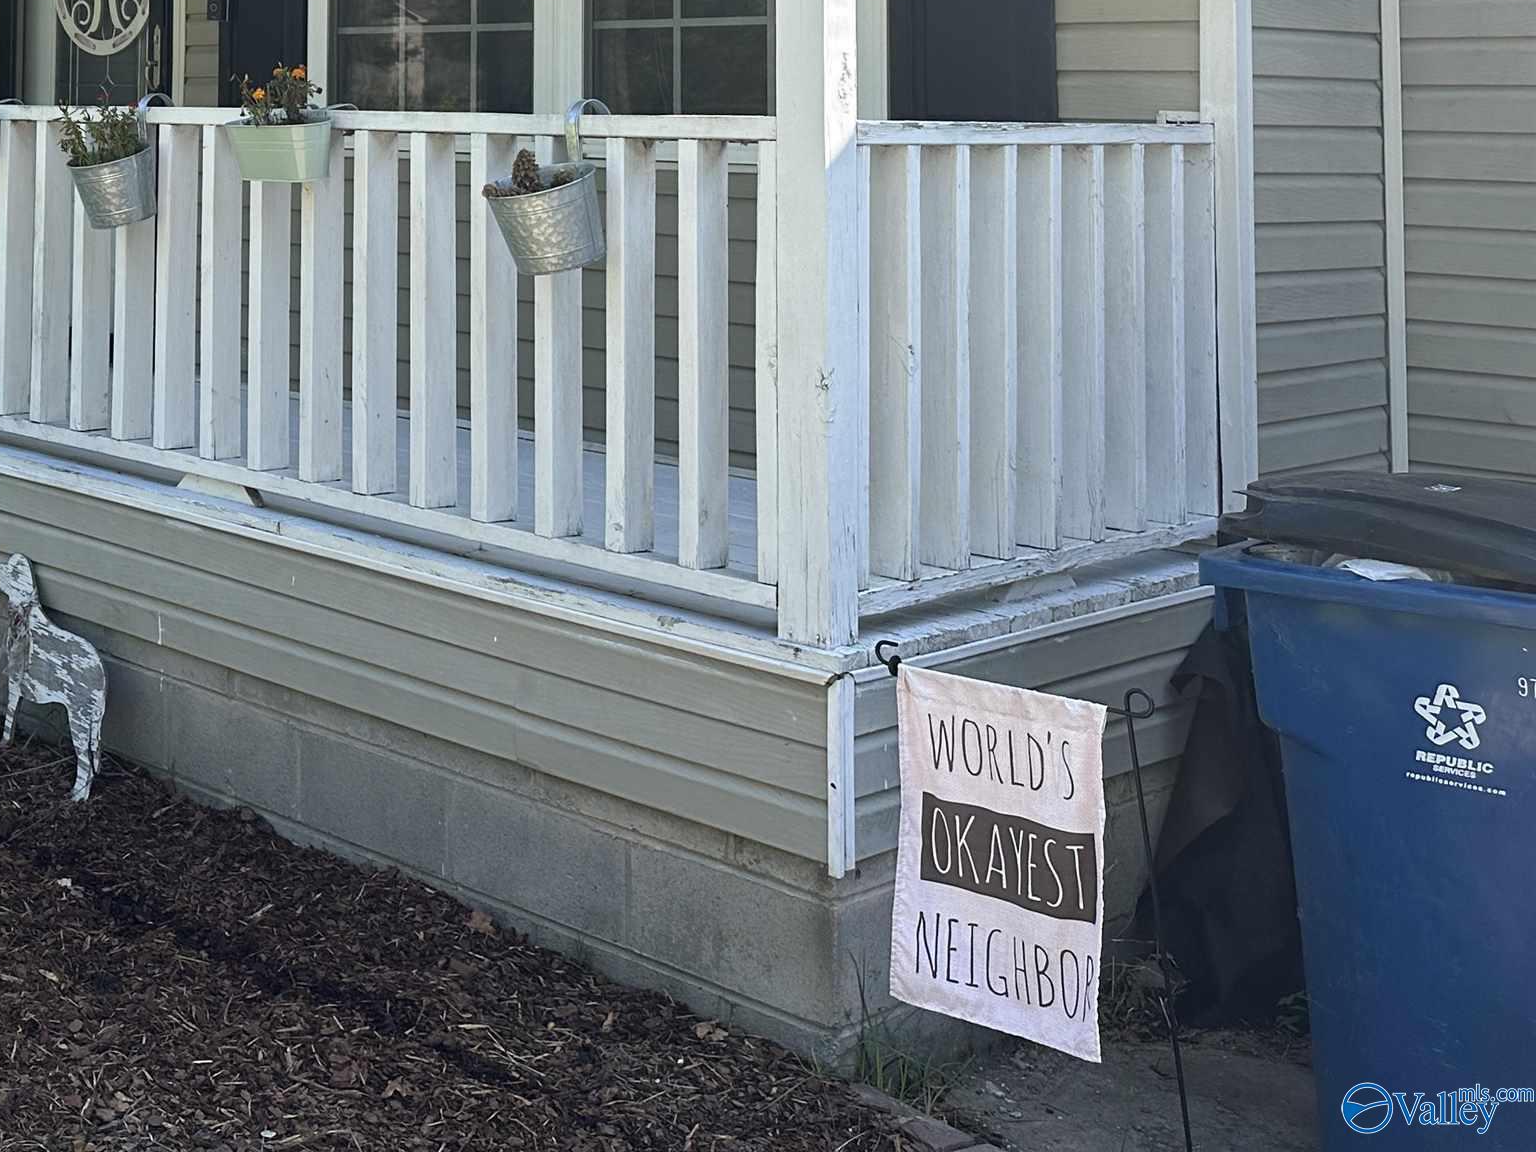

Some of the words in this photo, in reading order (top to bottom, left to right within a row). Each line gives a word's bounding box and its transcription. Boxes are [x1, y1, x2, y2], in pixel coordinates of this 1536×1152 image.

[928, 713, 1075, 801] WORLD'S
[1406, 771, 1507, 796] republicservices.com
[1415, 750, 1494, 773] REPUBLIC
[1432, 764, 1477, 779] SERVICES
[931, 807, 1084, 911] OKAYEST
[916, 911, 1095, 1022] NEIGHBOR
